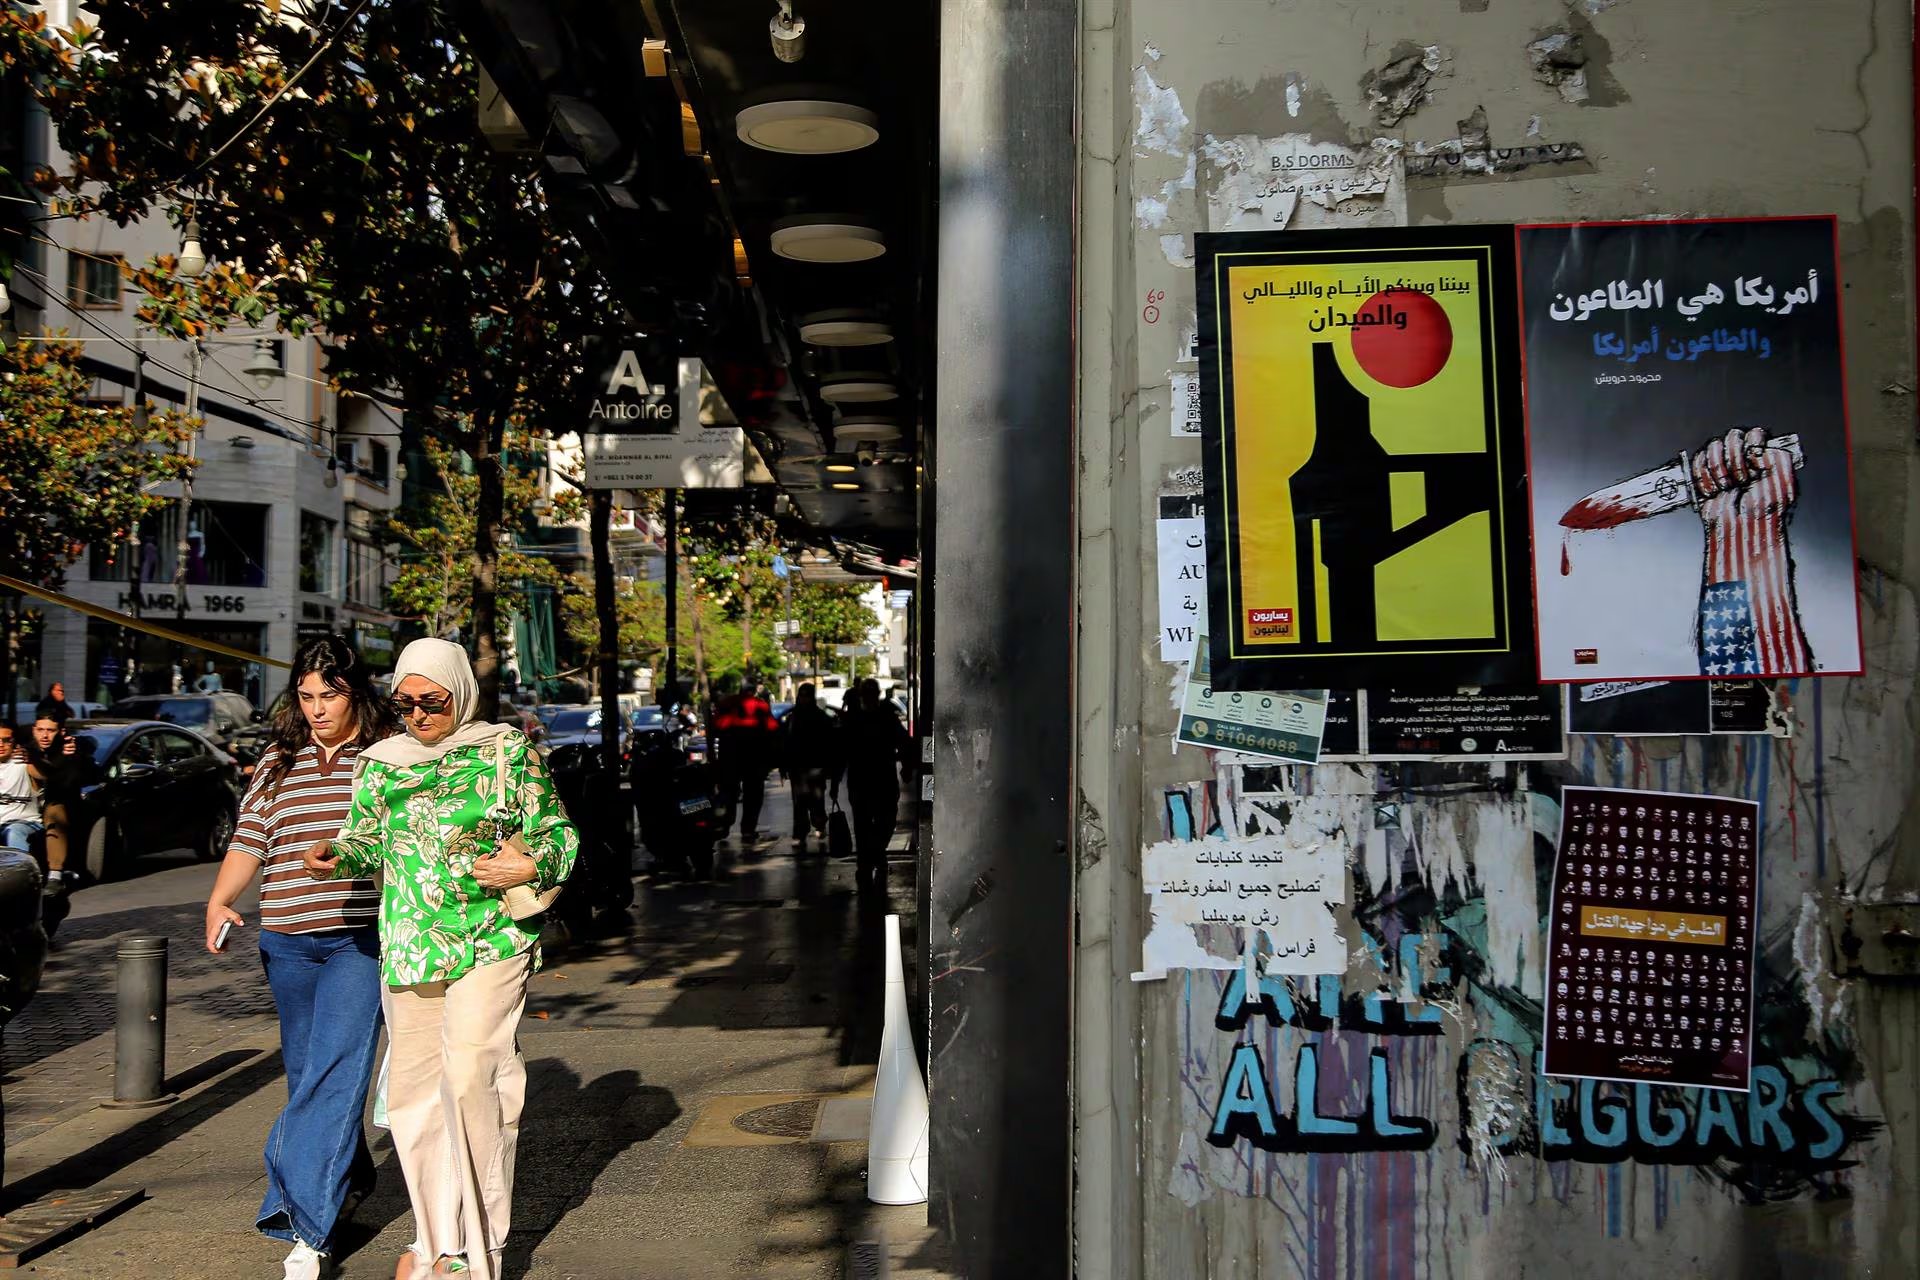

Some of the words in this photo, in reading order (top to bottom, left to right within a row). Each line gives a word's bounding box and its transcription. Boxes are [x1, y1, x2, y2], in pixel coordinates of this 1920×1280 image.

[1271, 154, 1294, 169] B.S
[1299, 154, 1354, 169] DORMS
[1384, 277, 1435, 297] وبينكم
[1439, 276, 1470, 294] بيننا
[1734, 268, 1819, 315] أمريكا
[1549, 279, 1664, 321] الطاعون
[1676, 282, 1725, 322] هي
[1308, 303, 1408, 332] والميدان
[1592, 325, 1660, 363] أمريكا
[1665, 327, 1772, 361] والطاعون
[605, 350, 666, 395] A.
[1628, 372, 1662, 385] محمود
[588, 399, 673, 419] Antoine
[204, 595, 245, 613] 1966
[1252, 610, 1289, 622] يساريون
[1215, 728, 1298, 754] 81064088
[1195, 850, 1243, 868] كنبايات
[1248, 850, 1284, 868] تنجيد
[1237, 883, 1272, 899] جميع
[1277, 879, 1321, 899] تصليح
[1251, 909, 1280, 926] رش
[1585, 913, 1620, 929] القتل
[1667, 918, 1687, 940] في
[1686, 920, 1722, 938] الطب
[1277, 938, 1316, 957] فراس
[1209, 1043, 1432, 1148] ALL
